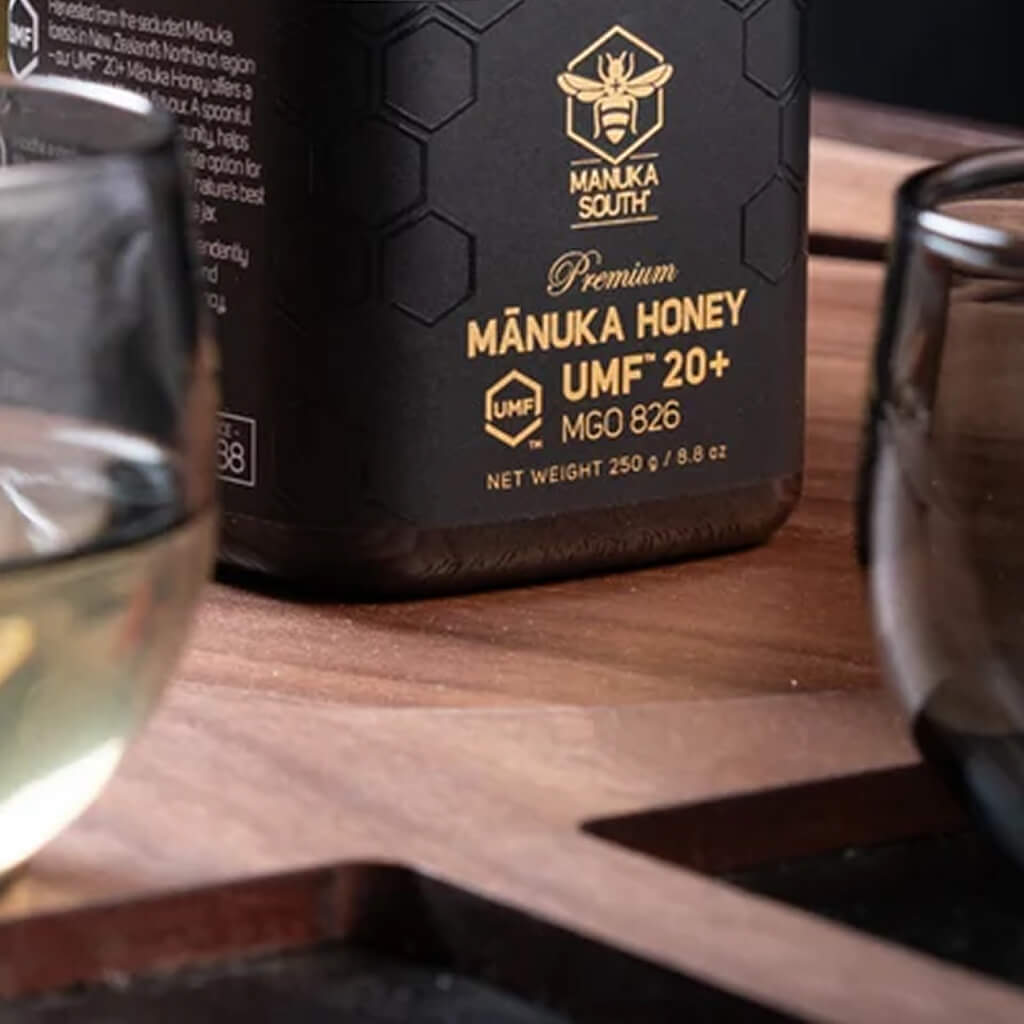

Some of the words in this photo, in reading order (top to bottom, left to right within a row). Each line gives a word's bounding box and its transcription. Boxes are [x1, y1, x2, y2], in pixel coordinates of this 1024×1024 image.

[94, 4, 117, 26] from
[119, 8, 136, 30] the
[217, 127, 250, 152] helps
[240, 183, 266, 206] best
[570, 163, 659, 194] MANUKA
[546, 249, 679, 297] Premium
[466, 306, 625, 358] MĀNUKA
[635, 288, 748, 340] HONEY
[662, 346, 730, 389] 20+
[493, 397, 536, 420] UMF
[561, 406, 624, 444] MGO
[629, 400, 682, 435] 826
[486, 469, 524, 491] NET
[530, 459, 603, 485] WEIGHT
[608, 454, 643, 476] 250
[647, 455, 658, 473] g
[662, 450, 672, 467] /
[677, 444, 704, 465] 8.8
[708, 444, 727, 460] oz
